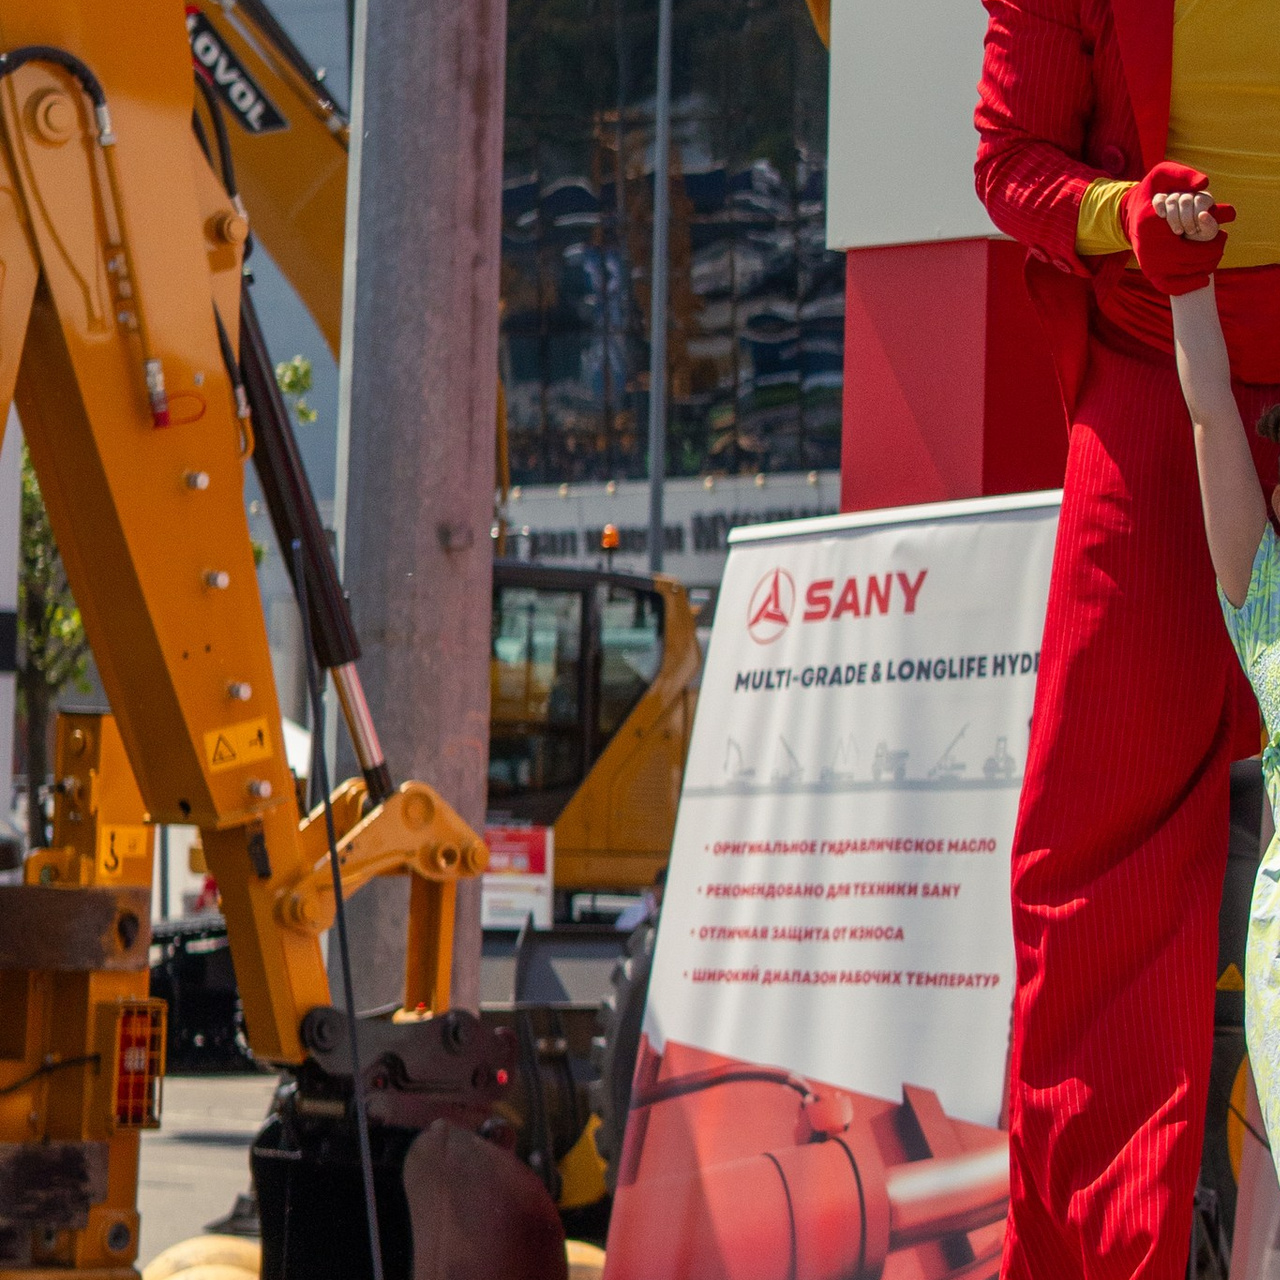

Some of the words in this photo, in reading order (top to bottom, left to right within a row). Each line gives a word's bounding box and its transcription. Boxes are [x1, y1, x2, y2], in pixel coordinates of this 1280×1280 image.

[803, 570, 928, 623] SANY
[734, 663, 868, 692] MULTI-GRADE
[871, 662, 881, 683] &
[887, 653, 987, 682] LONGLIFE
[713, 838, 817, 856] ОРИГИНАЛЬНОЕ
[820, 838, 944, 856] ГИДРАВЛИЧЕСКОЕ
[947, 837, 997, 854] МАСЛО
[706, 882, 824, 899] РЕКОМЕНДОВАНО
[826, 883, 851, 900] ДЛЯ
[853, 882, 918, 898] ТЕХНИКИ
[921, 883, 961, 899] SANY
[699, 925, 769, 941] ОТЛИЧНАЯ
[772, 925, 830, 943] ЗАЩИТА
[832, 926, 848, 941] ОТ
[849, 925, 905, 941] ИЗНОСА
[692, 965, 759, 984] ШИРОКИЙ
[762, 968, 837, 986] ДИАПАЗОН
[839, 970, 903, 987] РАБОЧИХ
[906, 970, 1001, 989] ТЕМПЕРАТУР
